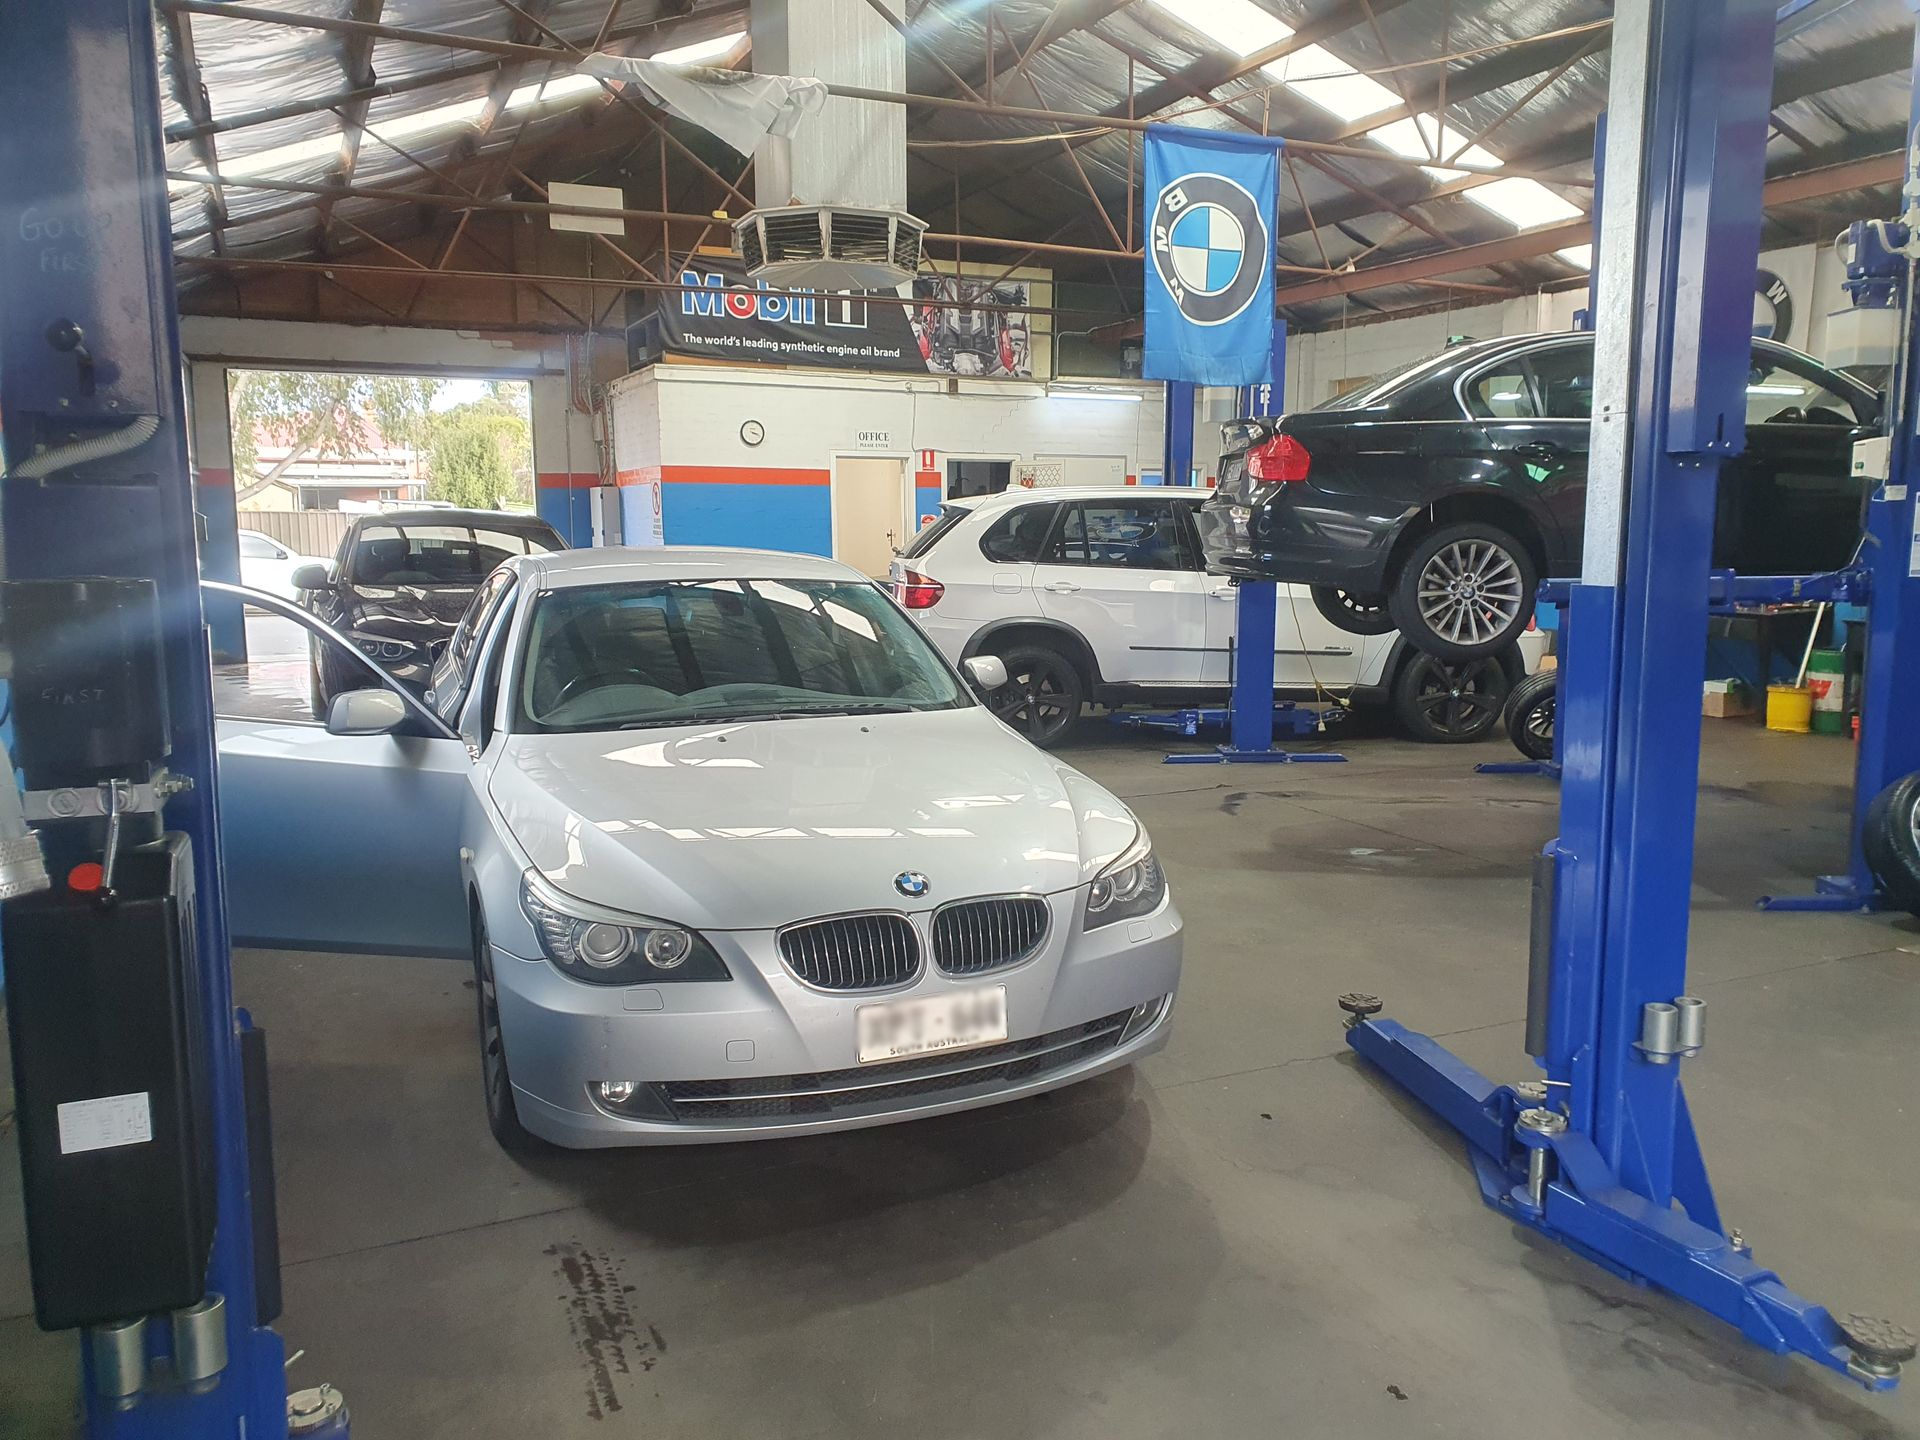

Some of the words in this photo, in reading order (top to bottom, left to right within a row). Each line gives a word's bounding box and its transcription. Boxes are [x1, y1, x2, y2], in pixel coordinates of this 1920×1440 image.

[681, 271, 815, 324] Mobil
[683, 333, 702, 344] The
[705, 336, 740, 347] world's
[743, 337, 778, 351] leading
[780, 341, 825, 354] synthetic
[826, 344, 858, 357] engine
[860, 346, 872, 356] oil
[873, 346, 900, 358] brand
[859, 431, 889, 441] OFFICE
